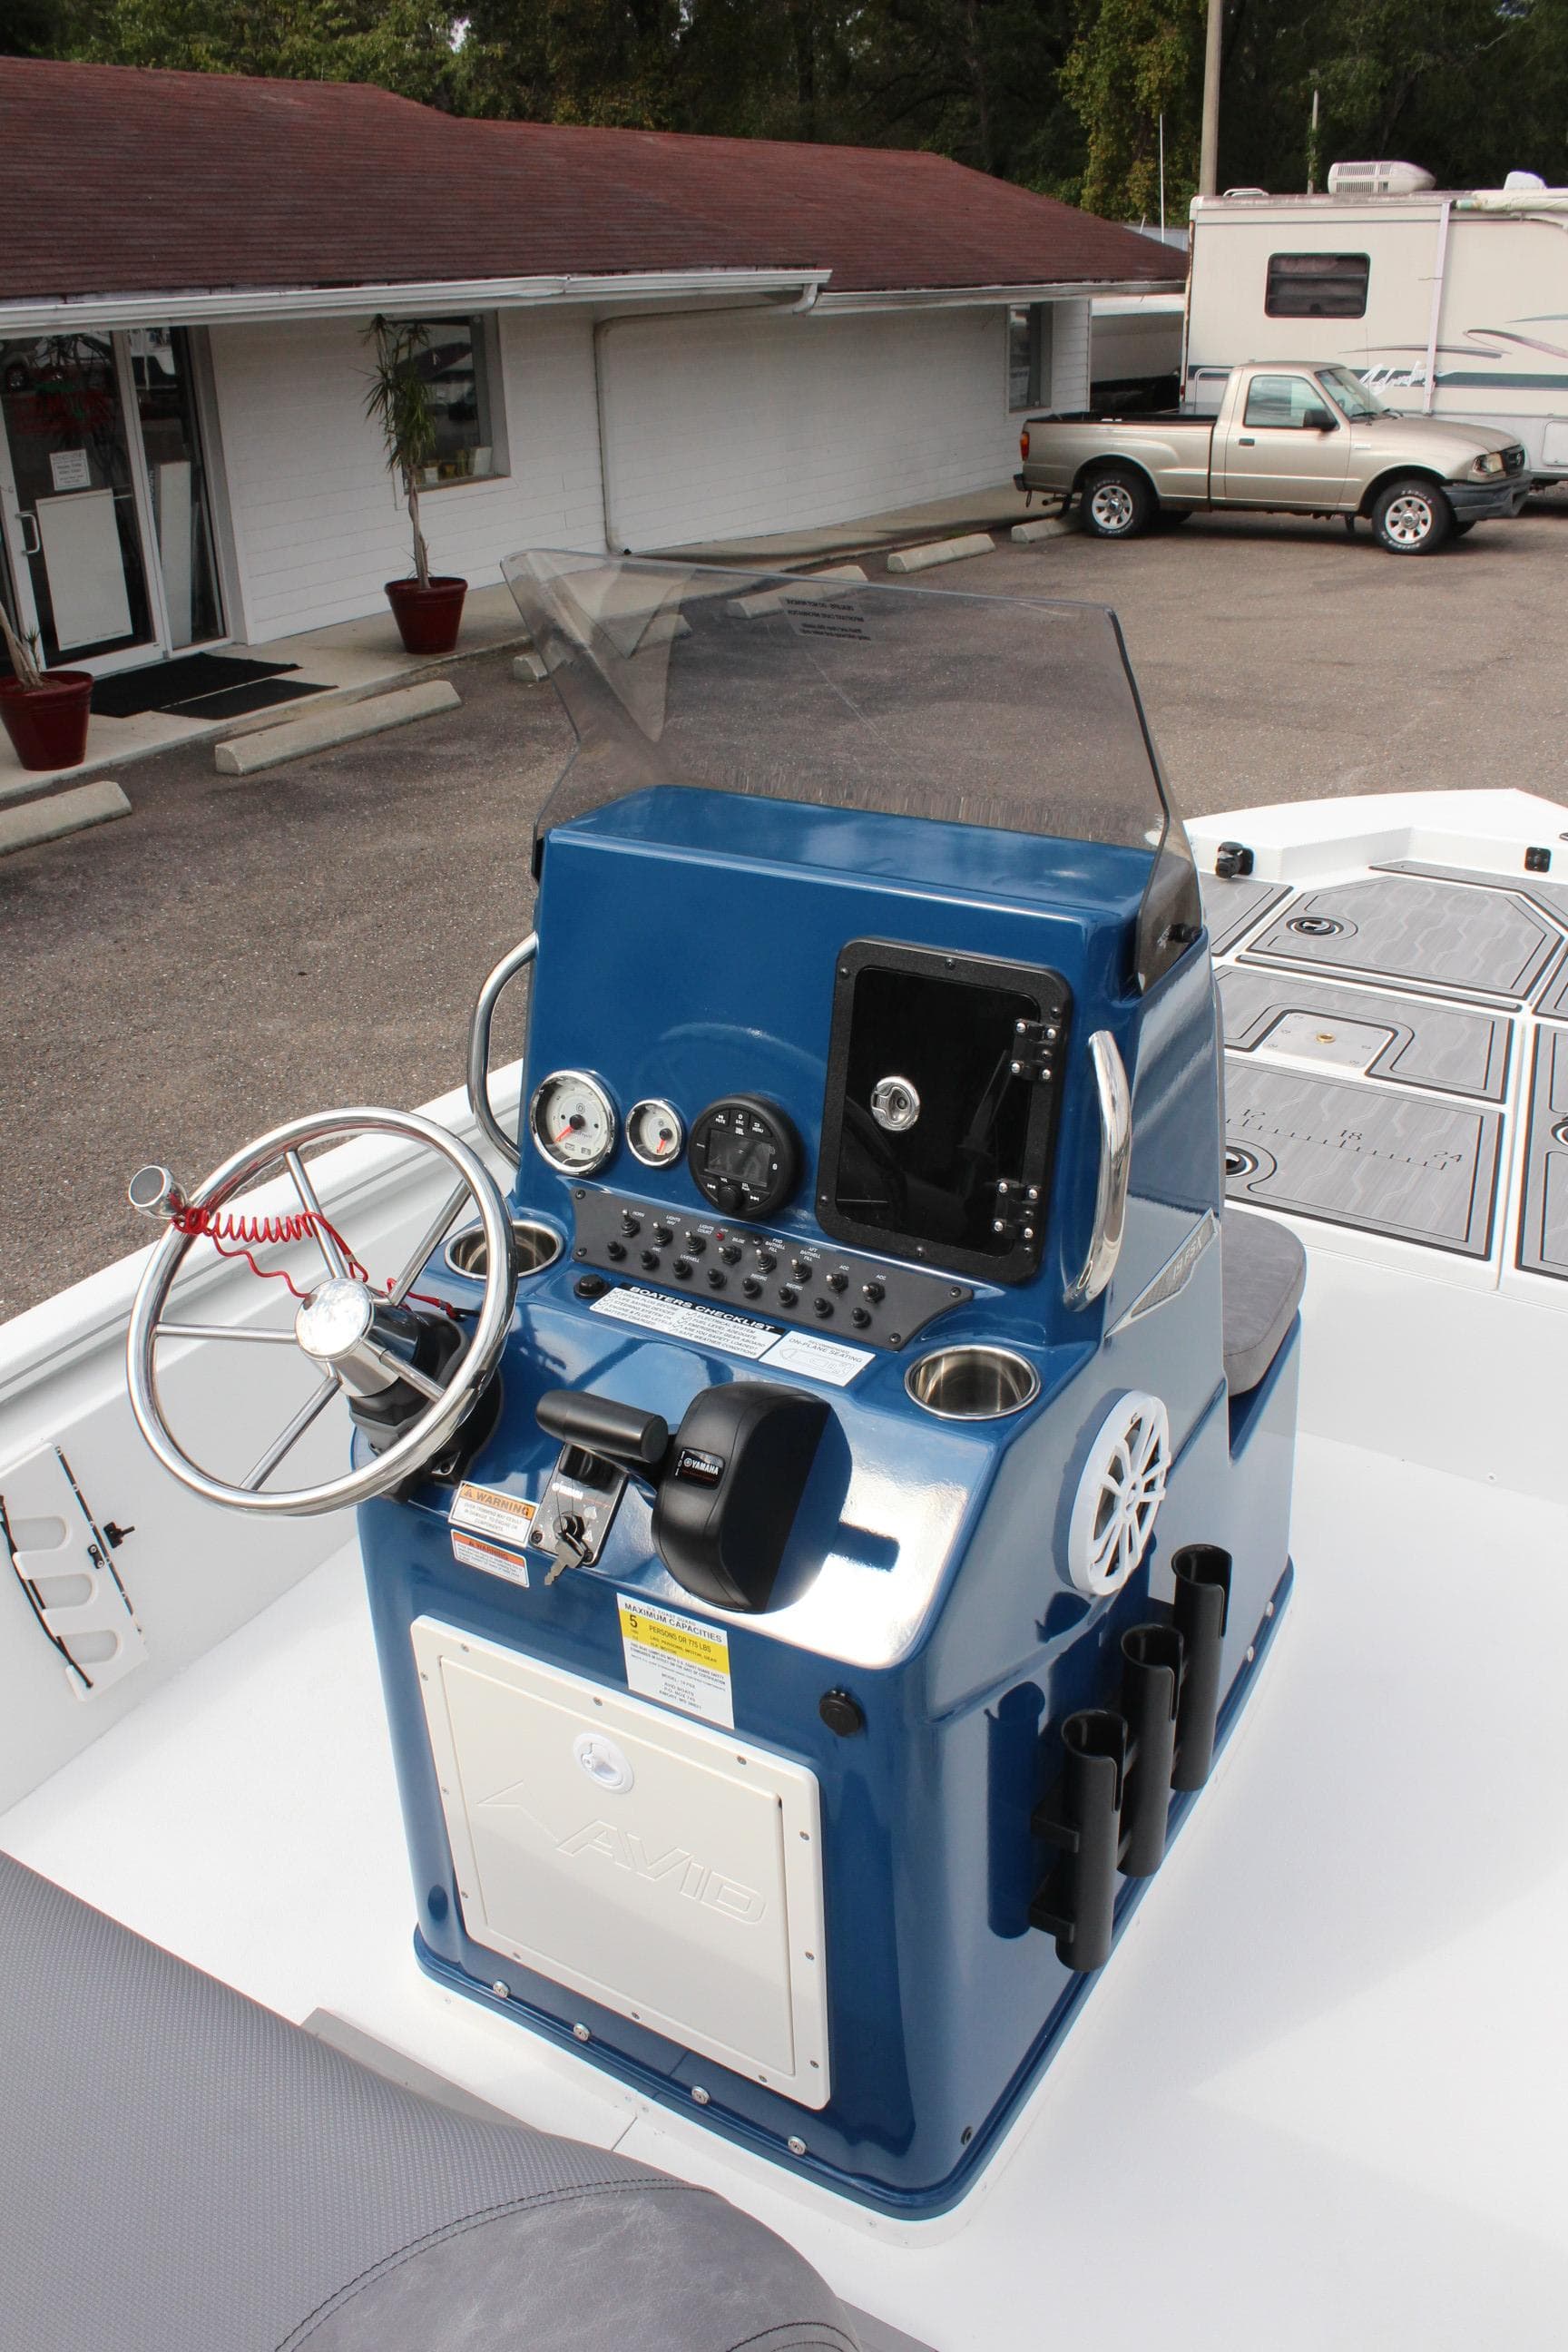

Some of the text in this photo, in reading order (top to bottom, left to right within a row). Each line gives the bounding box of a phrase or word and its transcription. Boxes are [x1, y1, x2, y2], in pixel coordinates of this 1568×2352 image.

[1242, 1109, 1266, 1118] 12
[1339, 1130, 1363, 1141] 18
[1433, 1150, 1463, 1162] 24
[629, 1287, 775, 1331] BOATERS CHECKLIST
[789, 1338, 863, 1363] ON-PLANE SEATING
[691, 1461, 720, 1475] YAMAHA
[476, 1491, 530, 1516] WARNING
[625, 1603, 722, 1642] MAXIMUM CAPACITIES
[630, 1614, 637, 1628] 5
[649, 1625, 677, 1641] PERSONS
[690, 1638, 699, 1648] 775
[700, 1643, 711, 1653] LBS
[555, 1818, 767, 1925] AVID
